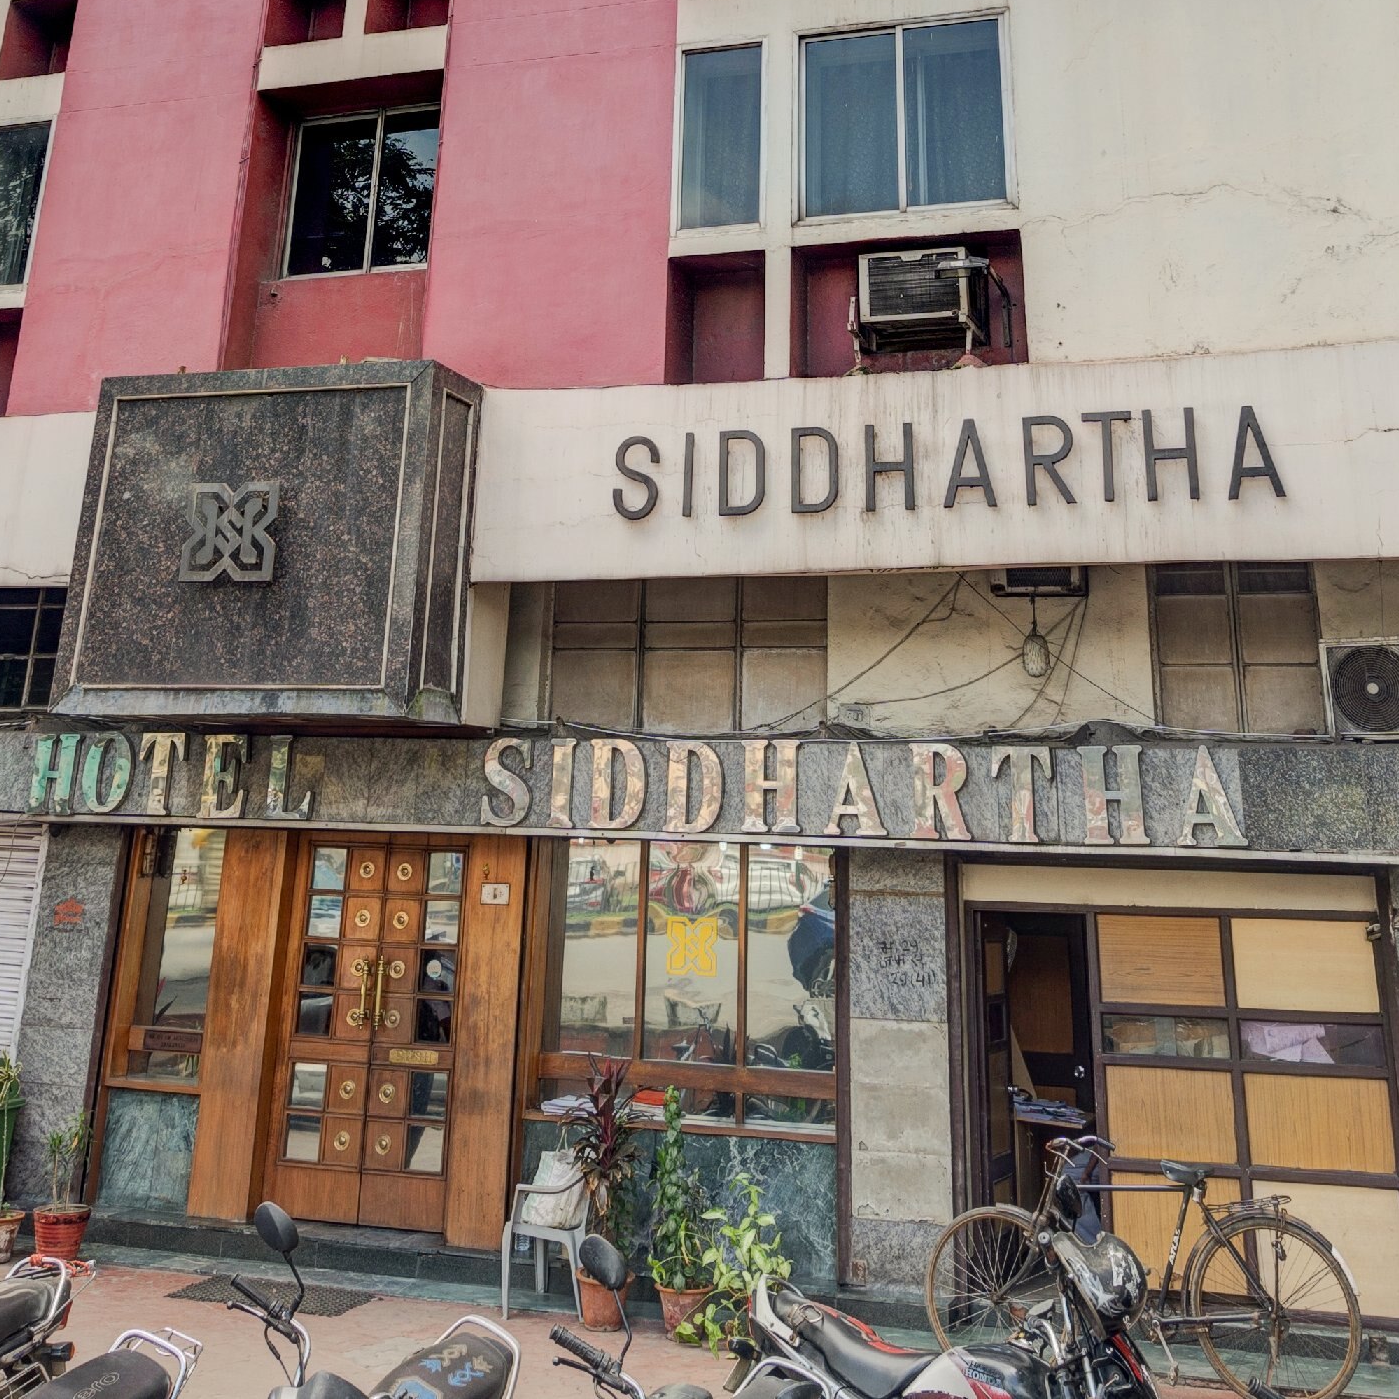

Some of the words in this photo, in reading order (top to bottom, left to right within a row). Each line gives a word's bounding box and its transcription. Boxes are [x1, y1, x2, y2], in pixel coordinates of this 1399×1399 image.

[611, 404, 1288, 521] SIDDHARTHA
[26, 731, 314, 822] HOTEL
[480, 735, 1250, 847] SIDDHARTHA
